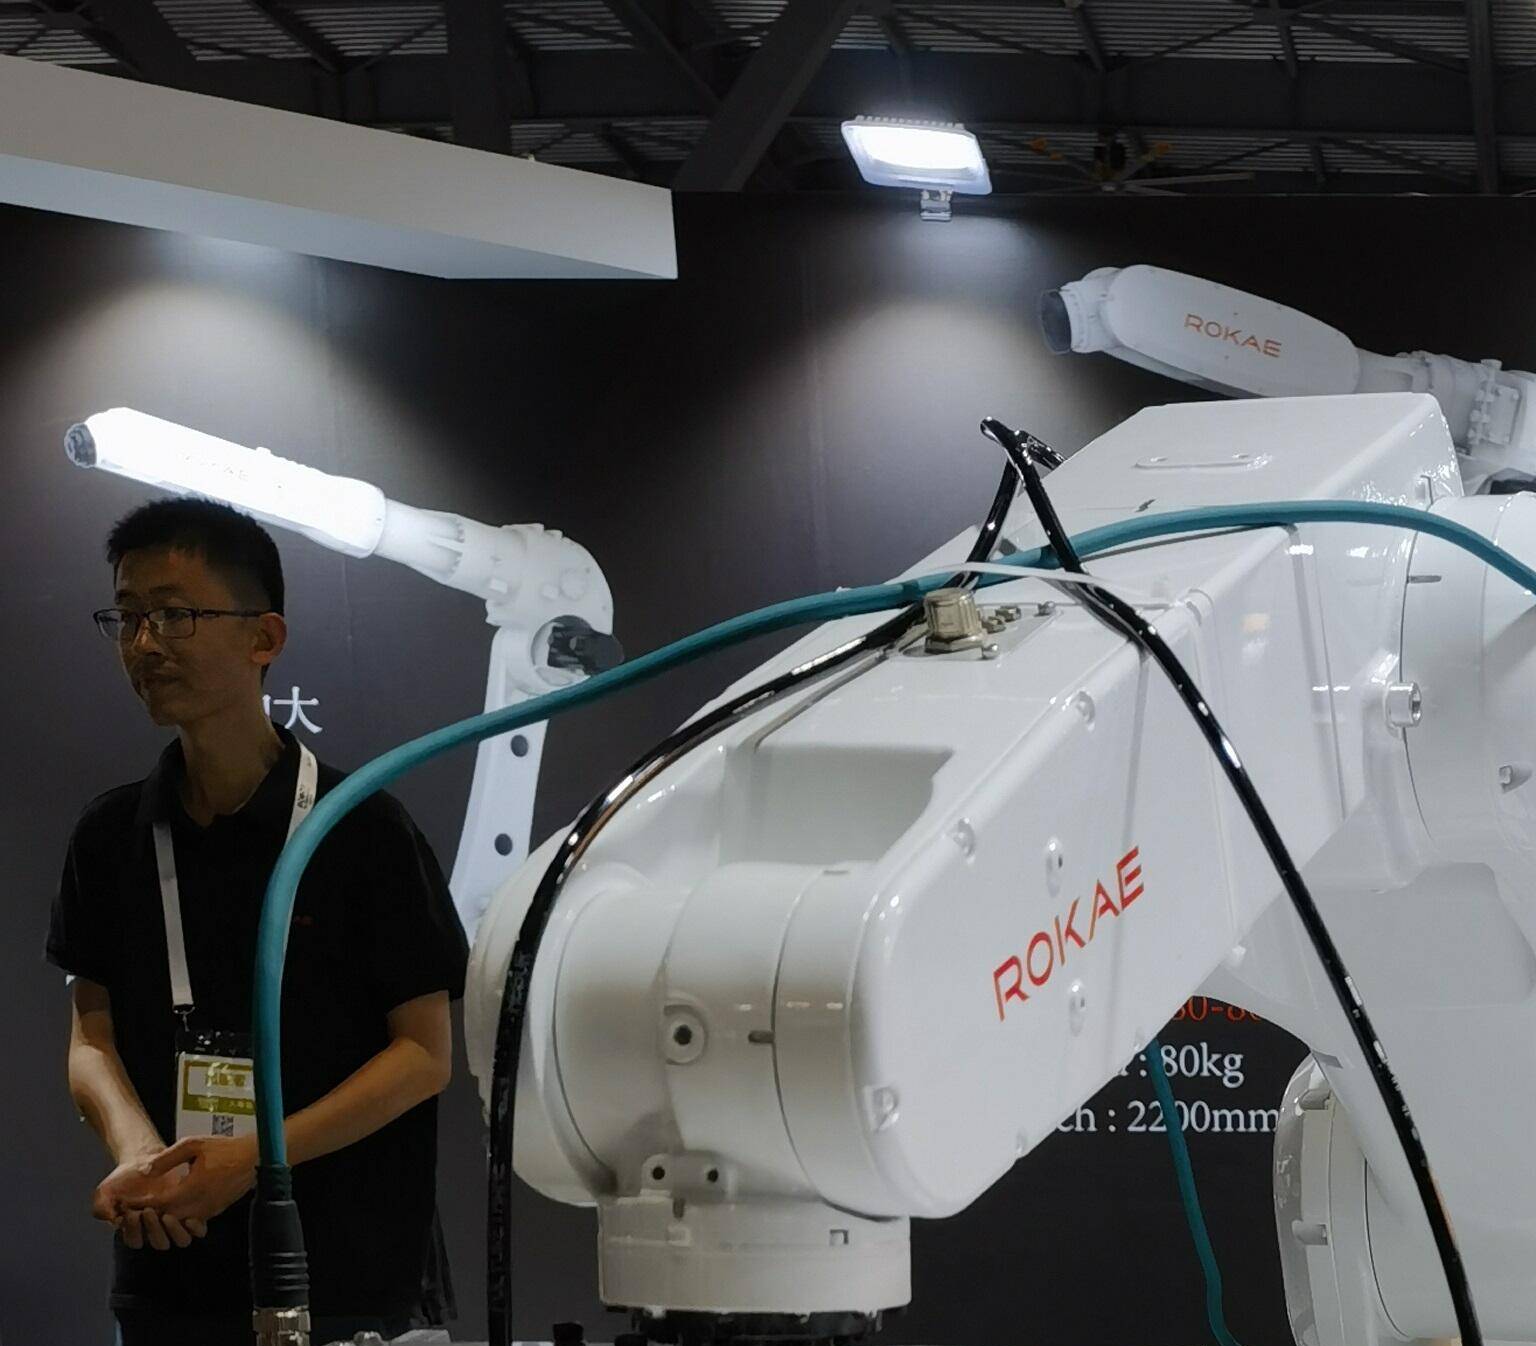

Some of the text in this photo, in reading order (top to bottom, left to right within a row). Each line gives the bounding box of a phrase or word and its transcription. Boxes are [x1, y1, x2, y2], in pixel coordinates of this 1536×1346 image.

[1184, 313, 1282, 358] ROKAE
[262, 686, 323, 734] 大
[993, 846, 1144, 1021] ROKAE
[1160, 1042, 1244, 1088] 80kg
